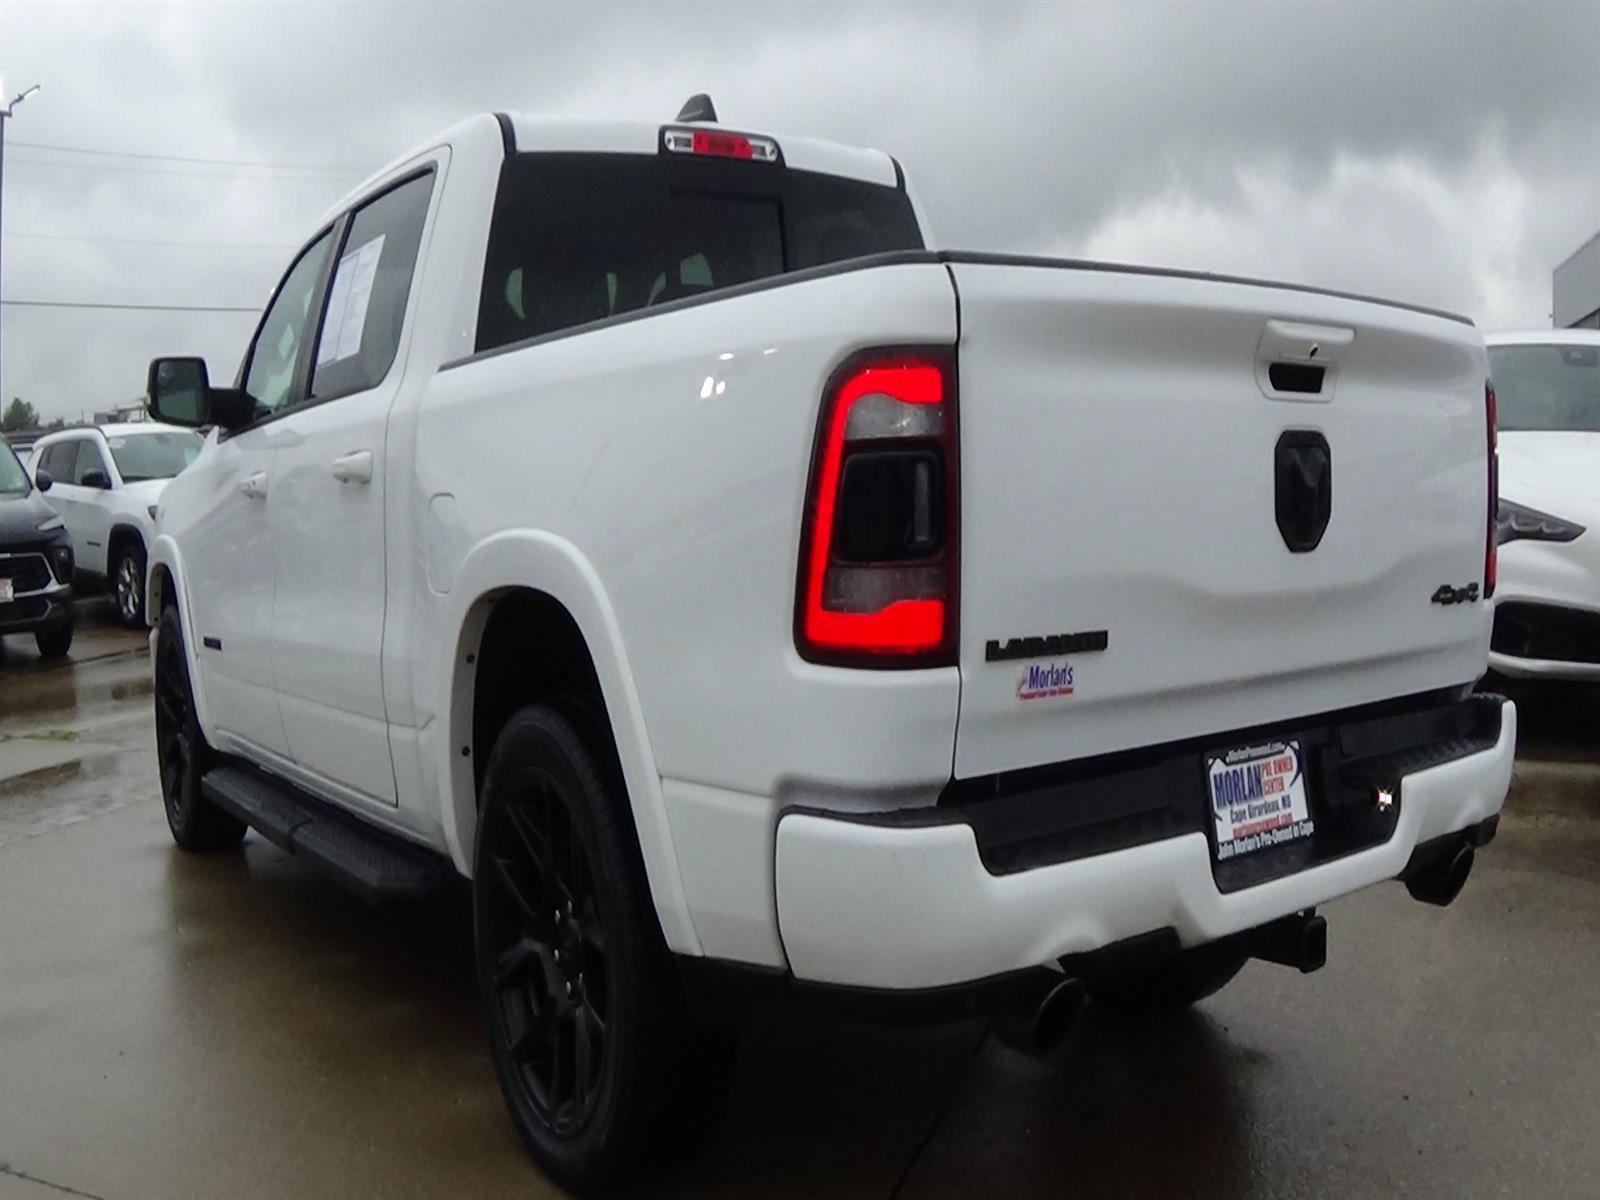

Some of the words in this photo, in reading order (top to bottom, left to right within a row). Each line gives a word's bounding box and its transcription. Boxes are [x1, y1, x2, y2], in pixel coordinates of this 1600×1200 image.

[1028, 661, 1073, 689] Morlan's
[1213, 764, 1263, 809] MORLAN
[1231, 806, 1246, 824] Cape
